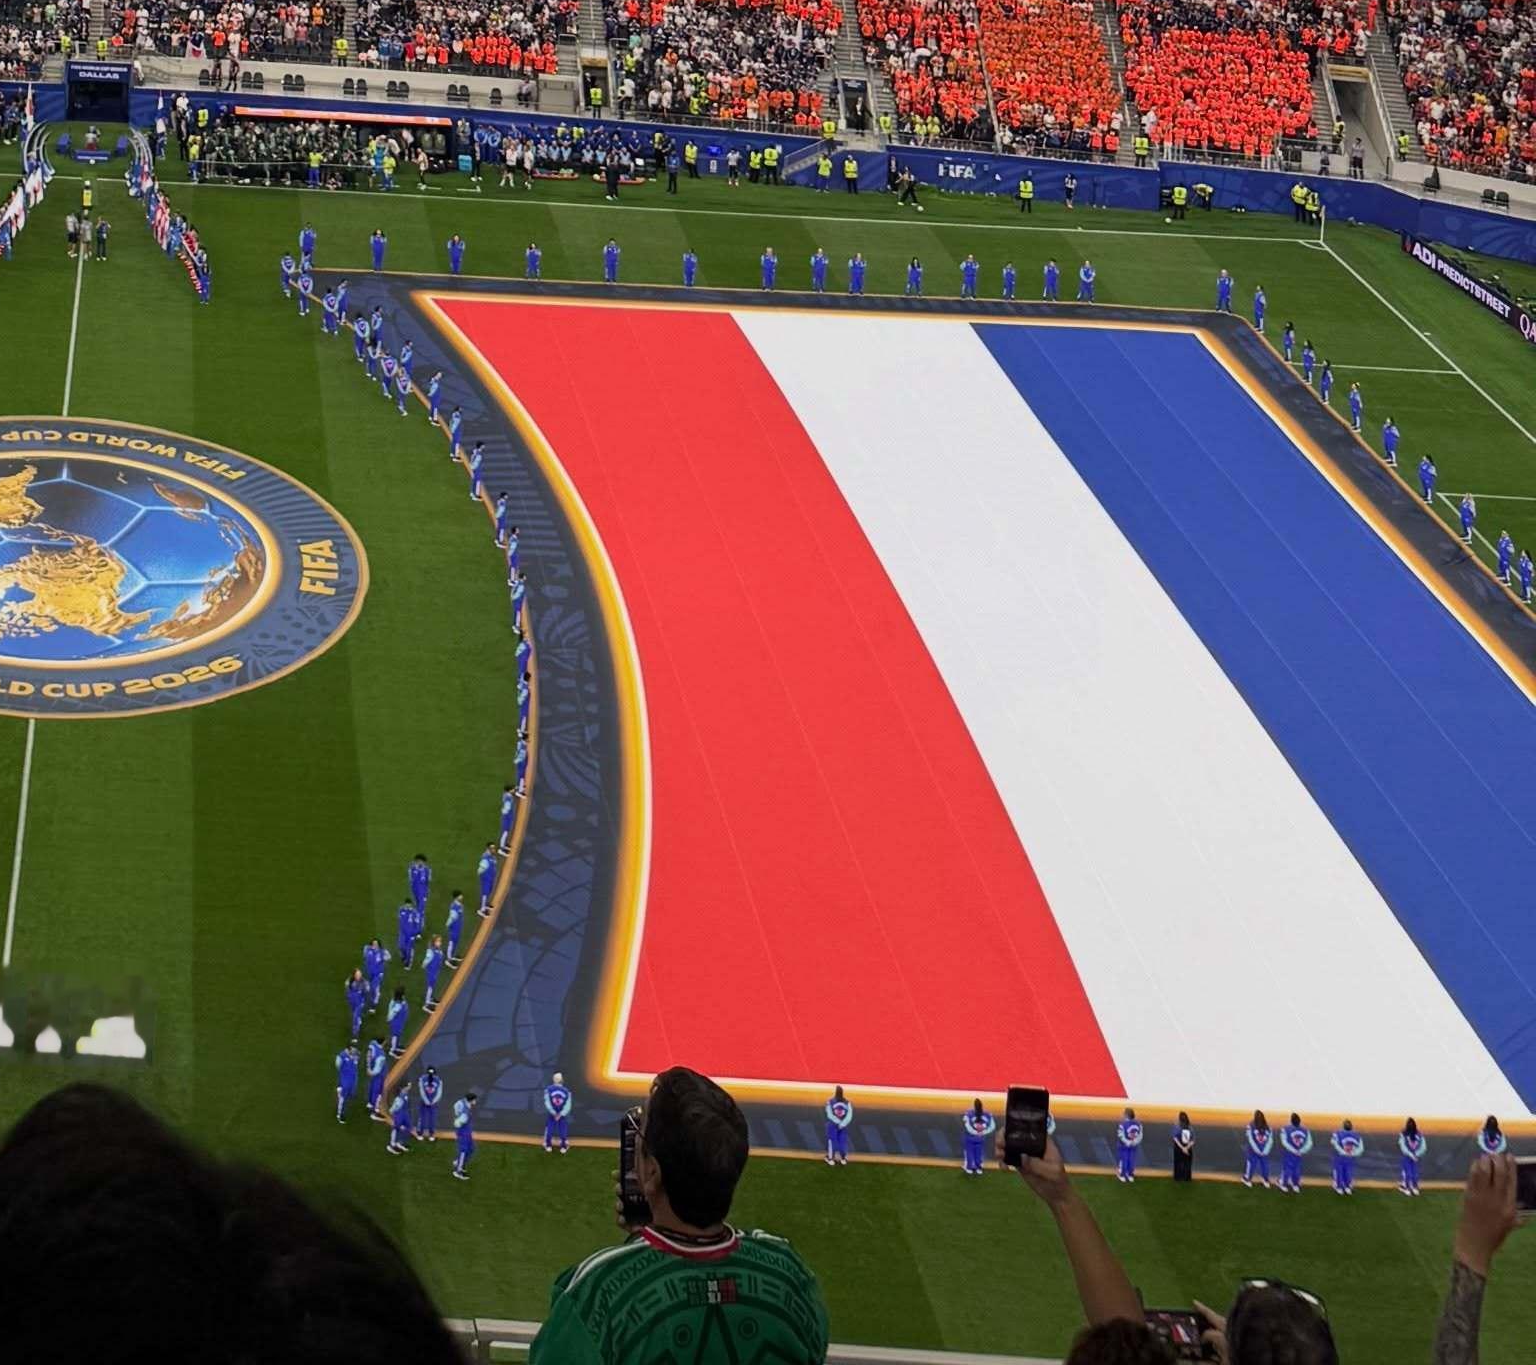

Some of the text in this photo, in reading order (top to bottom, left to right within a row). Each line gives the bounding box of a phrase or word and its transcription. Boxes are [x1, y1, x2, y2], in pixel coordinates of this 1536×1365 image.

[1412, 242, 1511, 318] ADI PREDICTSTREET
[1, 430, 63, 442] CUP
[68, 432, 177, 459] WORLD
[184, 451, 247, 481] FIFA
[299, 539, 341, 596] FIFA
[41, 682, 116, 698] CUP
[121, 655, 244, 695] 2026
